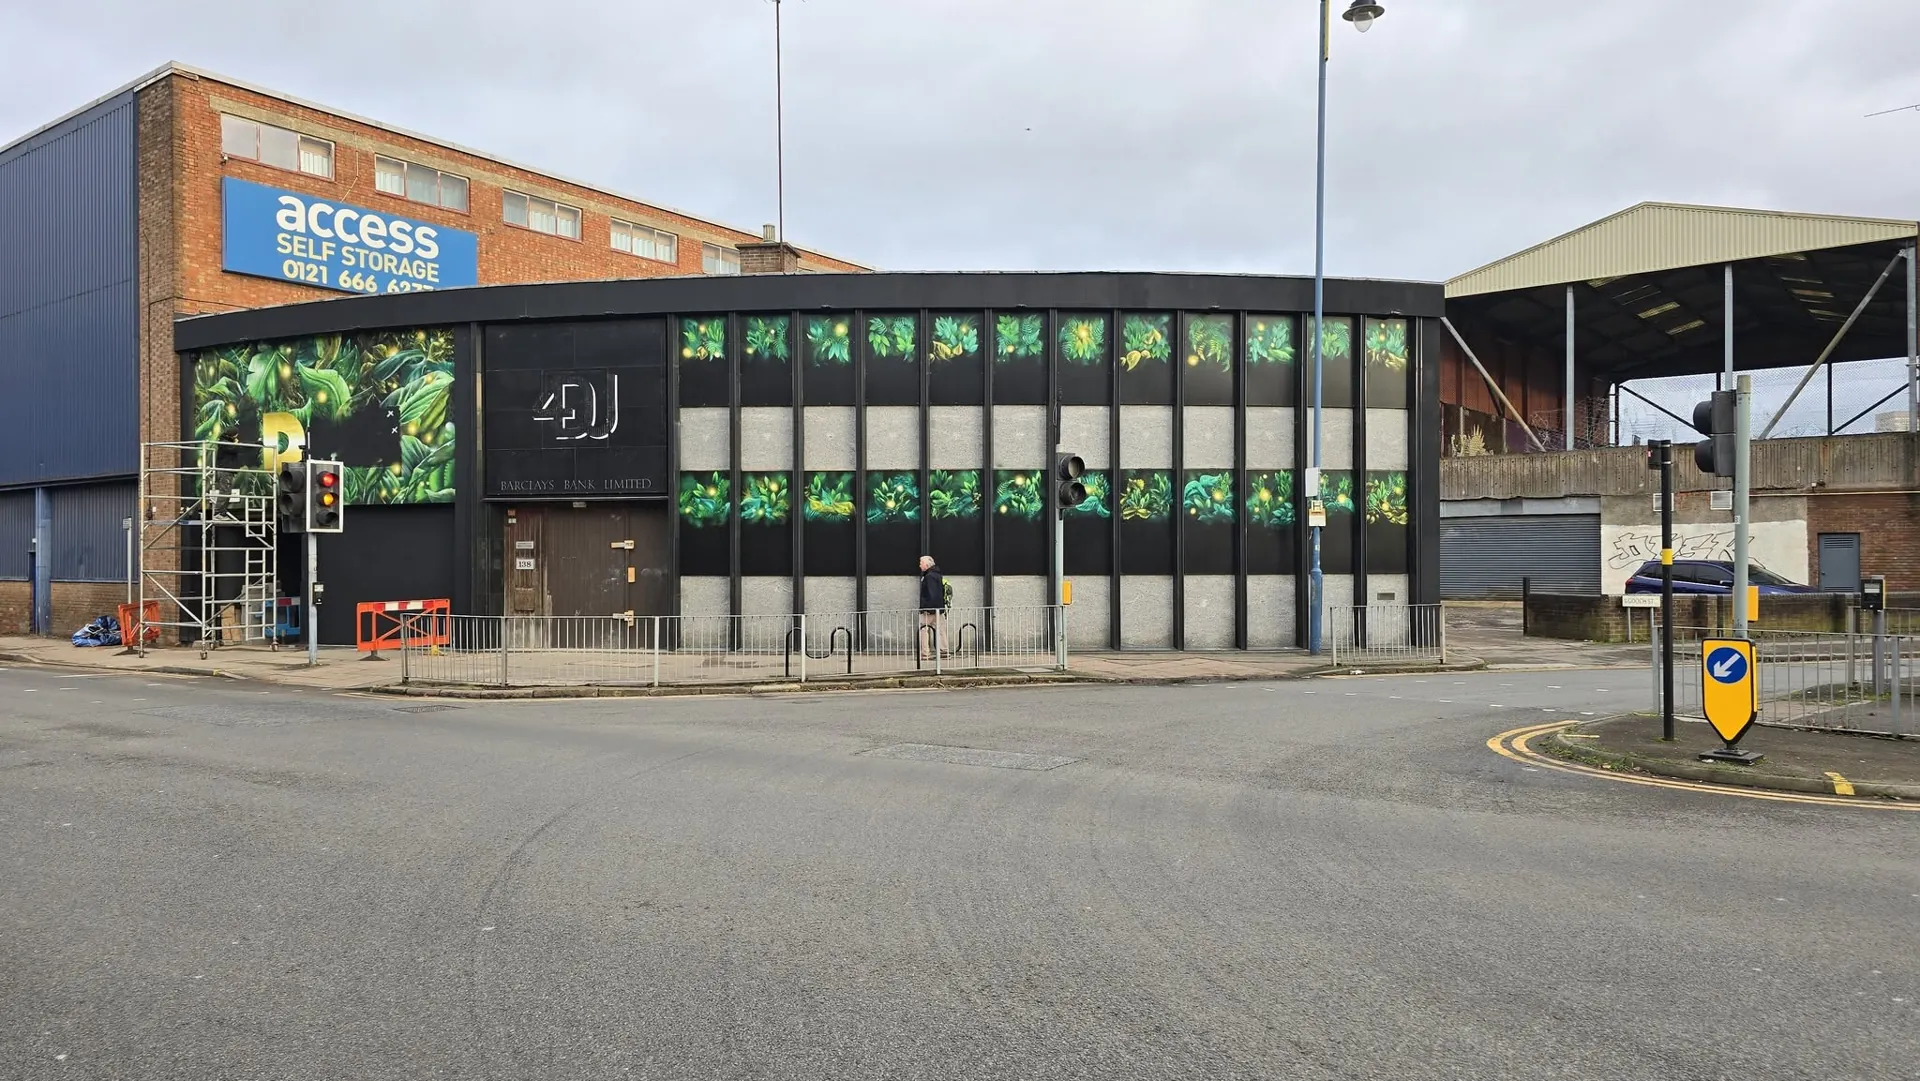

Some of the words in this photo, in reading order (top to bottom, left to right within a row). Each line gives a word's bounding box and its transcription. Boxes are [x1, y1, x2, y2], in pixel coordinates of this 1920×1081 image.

[276, 195, 439, 259] access
[276, 232, 336, 262] SELF
[341, 245, 440, 283] STORAGE
[282, 259, 328, 285] 0121
[338, 269, 378, 293] 666
[387, 278, 435, 293] 62
[500, 479, 555, 491] BARCLAYS
[564, 479, 596, 491] BANK
[604, 478, 652, 490] LIMITED
